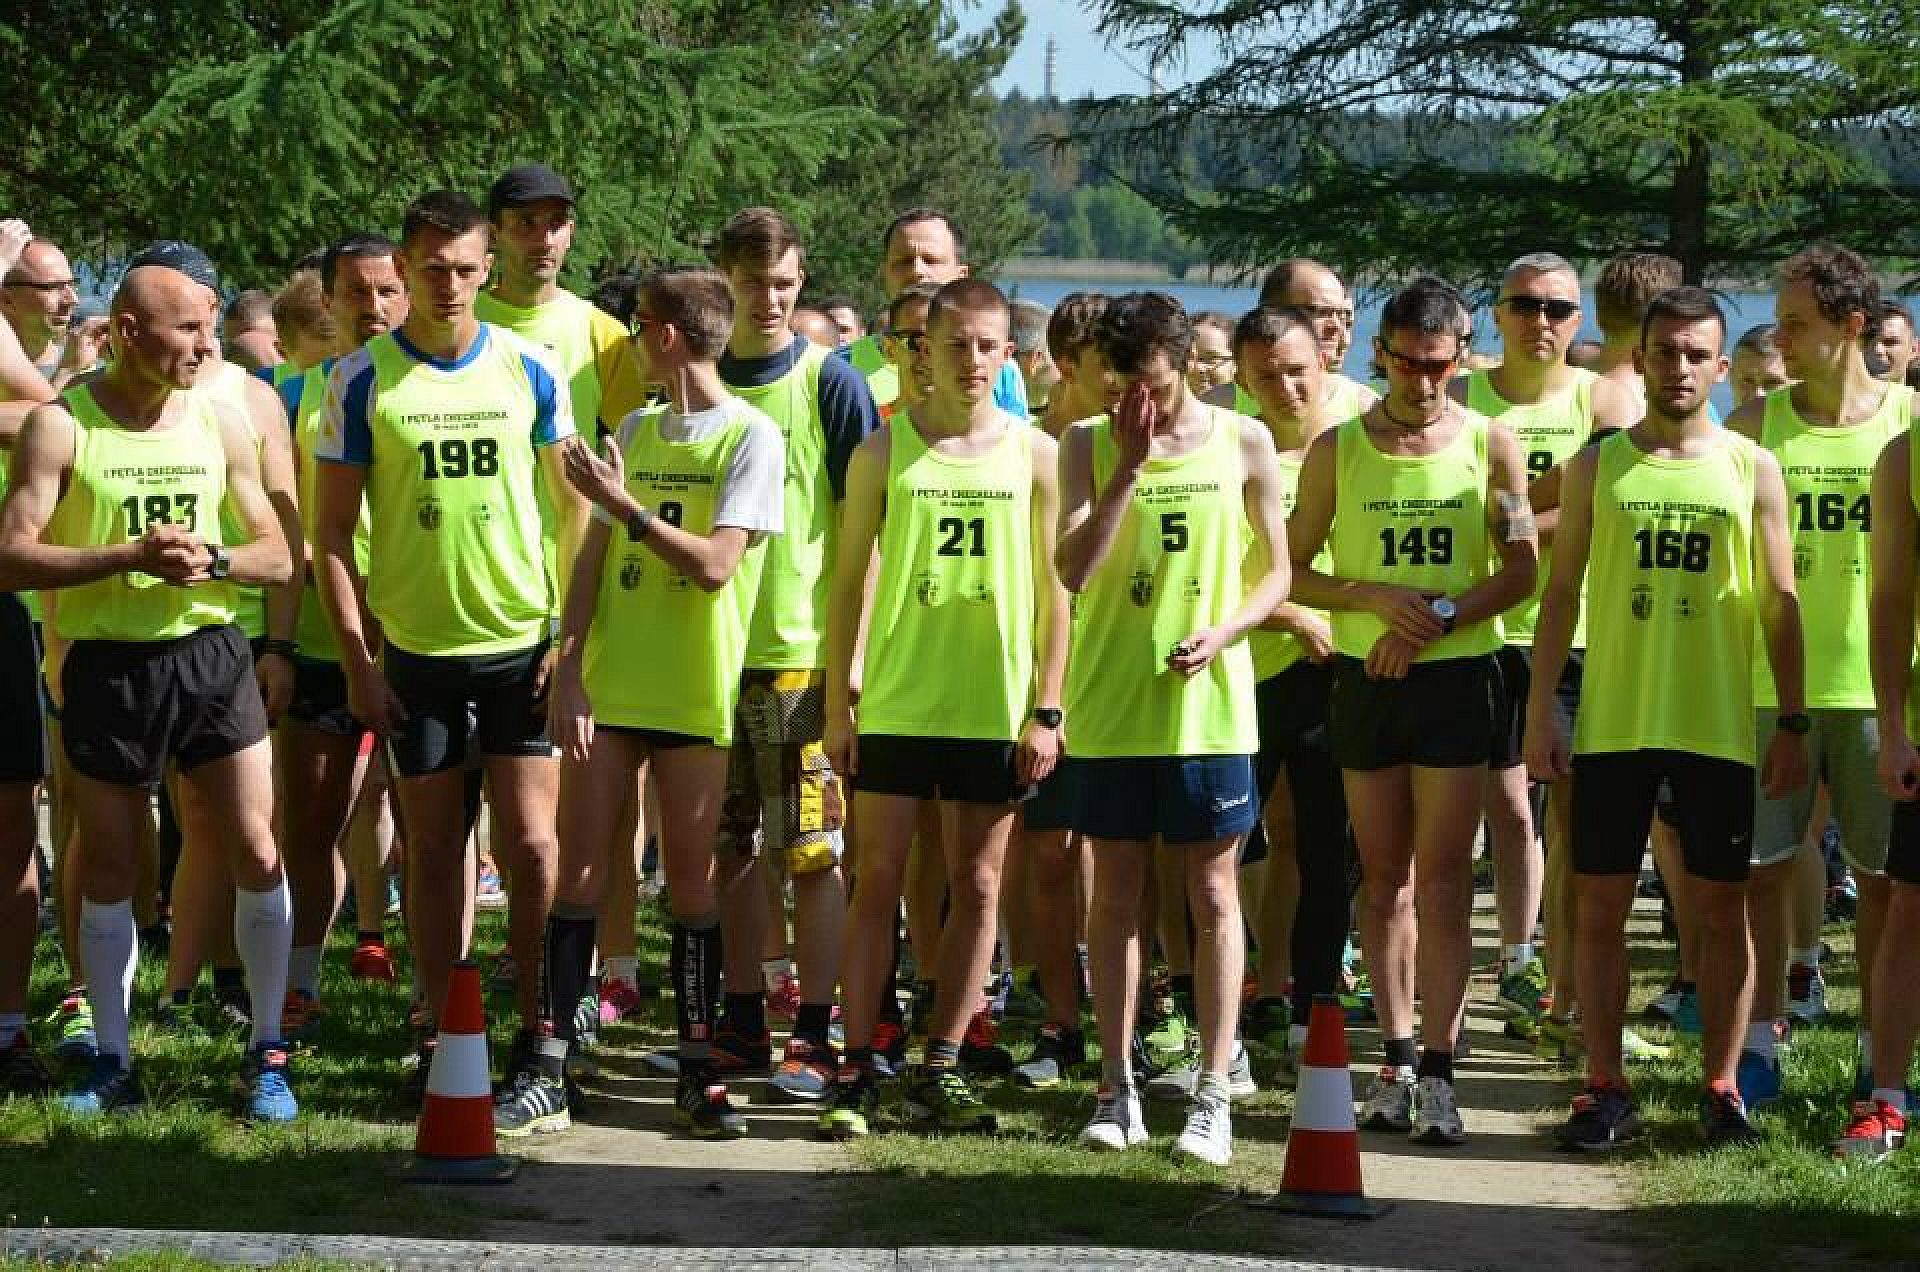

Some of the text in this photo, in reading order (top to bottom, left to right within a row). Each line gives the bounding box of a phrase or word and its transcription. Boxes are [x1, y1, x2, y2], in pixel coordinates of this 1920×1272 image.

[417, 437, 499, 480] 198
[122, 493, 198, 536] 183
[1160, 511, 1188, 553] 5
[1794, 493, 1872, 533] 164
[937, 517, 986, 556] 21
[1380, 527, 1453, 567] 149
[1634, 530, 1711, 574] 168
